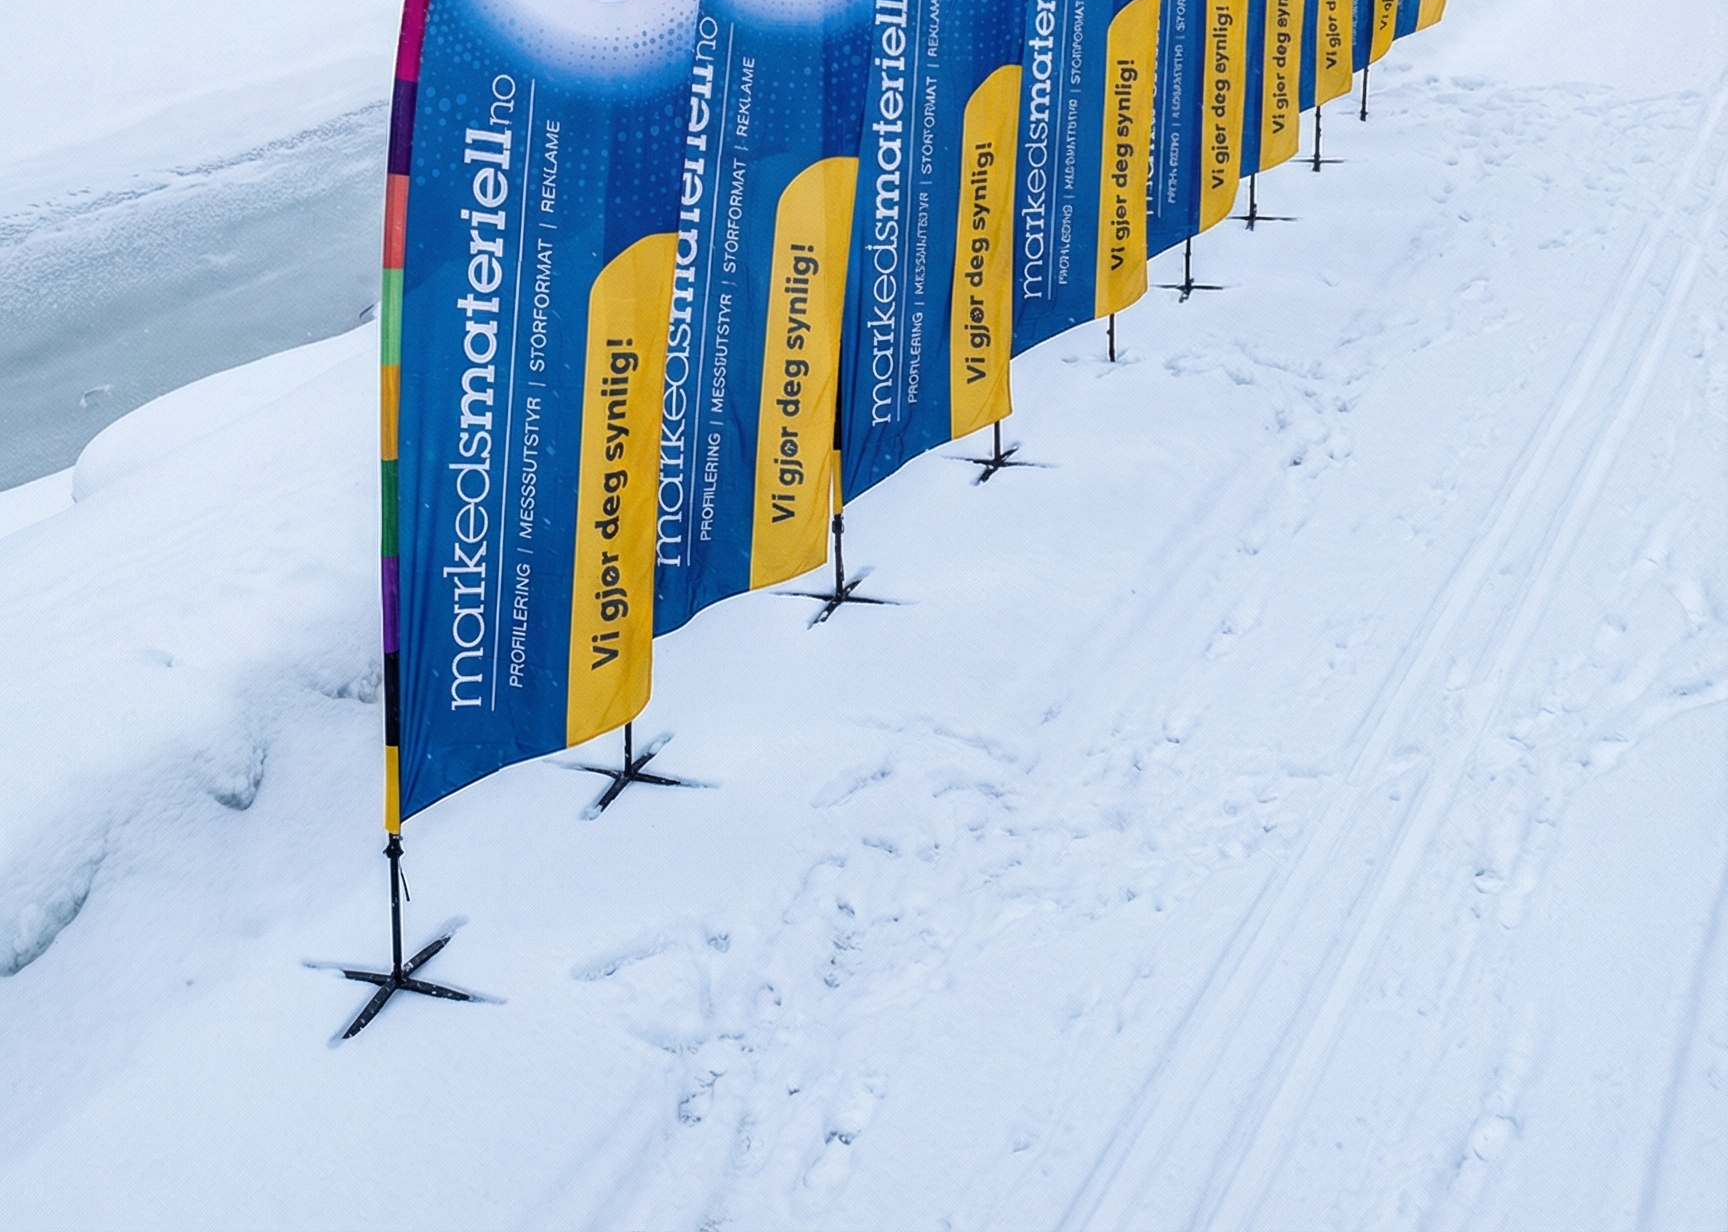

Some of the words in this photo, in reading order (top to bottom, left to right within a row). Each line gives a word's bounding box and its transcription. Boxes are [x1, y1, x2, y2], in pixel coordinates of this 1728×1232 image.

[1114, 60, 1138, 138] synlig!
[1272, 114, 1285, 134] Vi
[971, 141, 994, 231] synlig!
[1112, 143, 1133, 188] deg
[1211, 169, 1224, 190] Vi
[723, 158, 747, 274] STORFORMAT
[965, 238, 990, 288] deg
[1111, 246, 1125, 271] Vi
[530, 238, 553, 372] STORFORMAT
[775, 359, 809, 418] deg
[965, 357, 986, 385] Vi
[595, 469, 628, 540] deg
[771, 493, 796, 524] Vi
[591, 631, 620, 671] Vi
